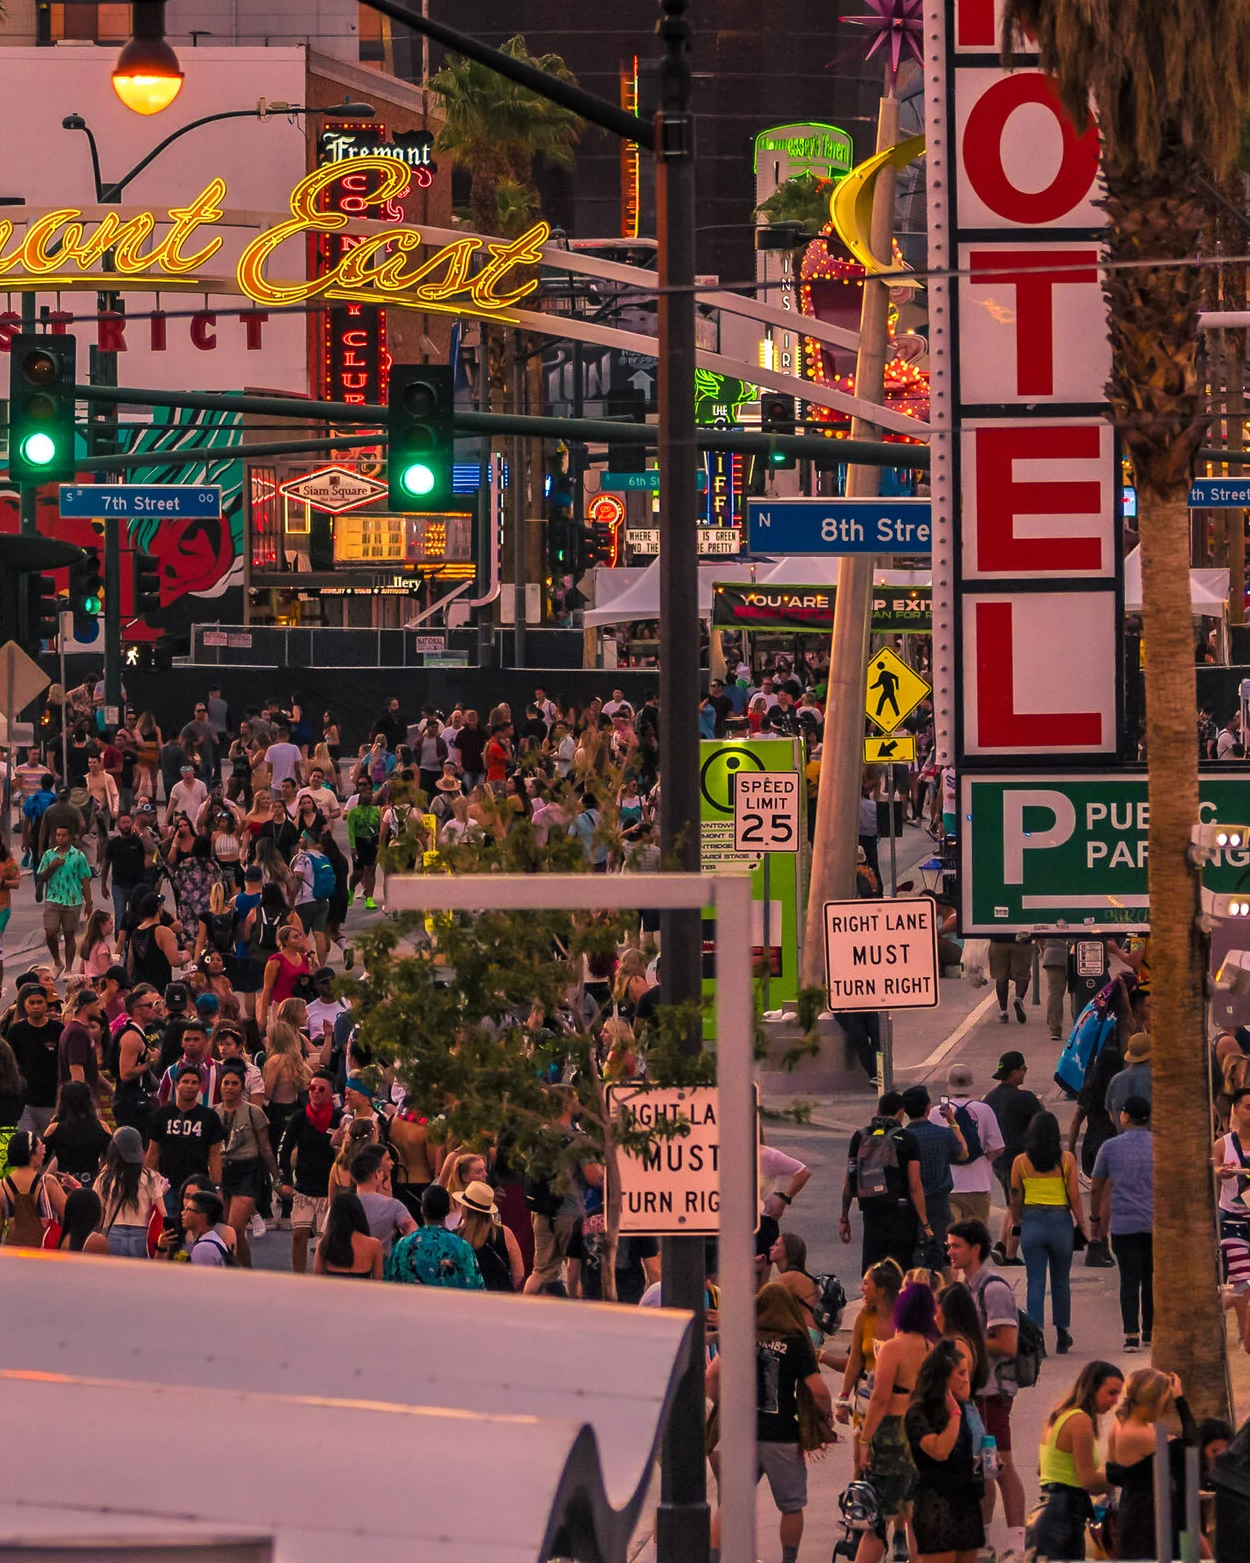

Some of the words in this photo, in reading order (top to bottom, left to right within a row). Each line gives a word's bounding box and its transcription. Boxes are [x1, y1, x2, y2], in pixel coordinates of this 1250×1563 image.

[322, 132, 431, 167] Fremont
[822, 133, 849, 163] Tavern
[237, 155, 552, 310] East
[628, 476, 646, 486] 6th
[303, 485, 329, 496] Siam
[331, 485, 368, 498] Square
[66, 493, 73, 502] S
[101, 496, 127, 511] 7th
[134, 496, 180, 511] Street
[629, 531, 652, 541] WHERE
[715, 531, 736, 541] GREEN
[758, 512, 771, 527] N
[821, 518, 864, 542] 8th
[877, 518, 930, 542] Stre
[647, 543, 659, 553] THE
[708, 543, 733, 553] PRETTY
[740, 594, 781, 607] YOU
[788, 595, 829, 608] ARE
[896, 611, 921, 620] FOR
[741, 781, 794, 793] SPEED
[746, 798, 788, 809] LIMIT
[741, 814, 793, 843] 25
[1003, 790, 1076, 884] P
[832, 915, 878, 933] RIGHT
[886, 913, 928, 931] LANE
[852, 944, 910, 966] MUST
[834, 979, 876, 996] TURN
[885, 977, 931, 995] RIGHT
[622, 1103, 680, 1126] IGHT
[691, 1103, 717, 1126] LA
[685, 1191, 720, 1213] RIG
